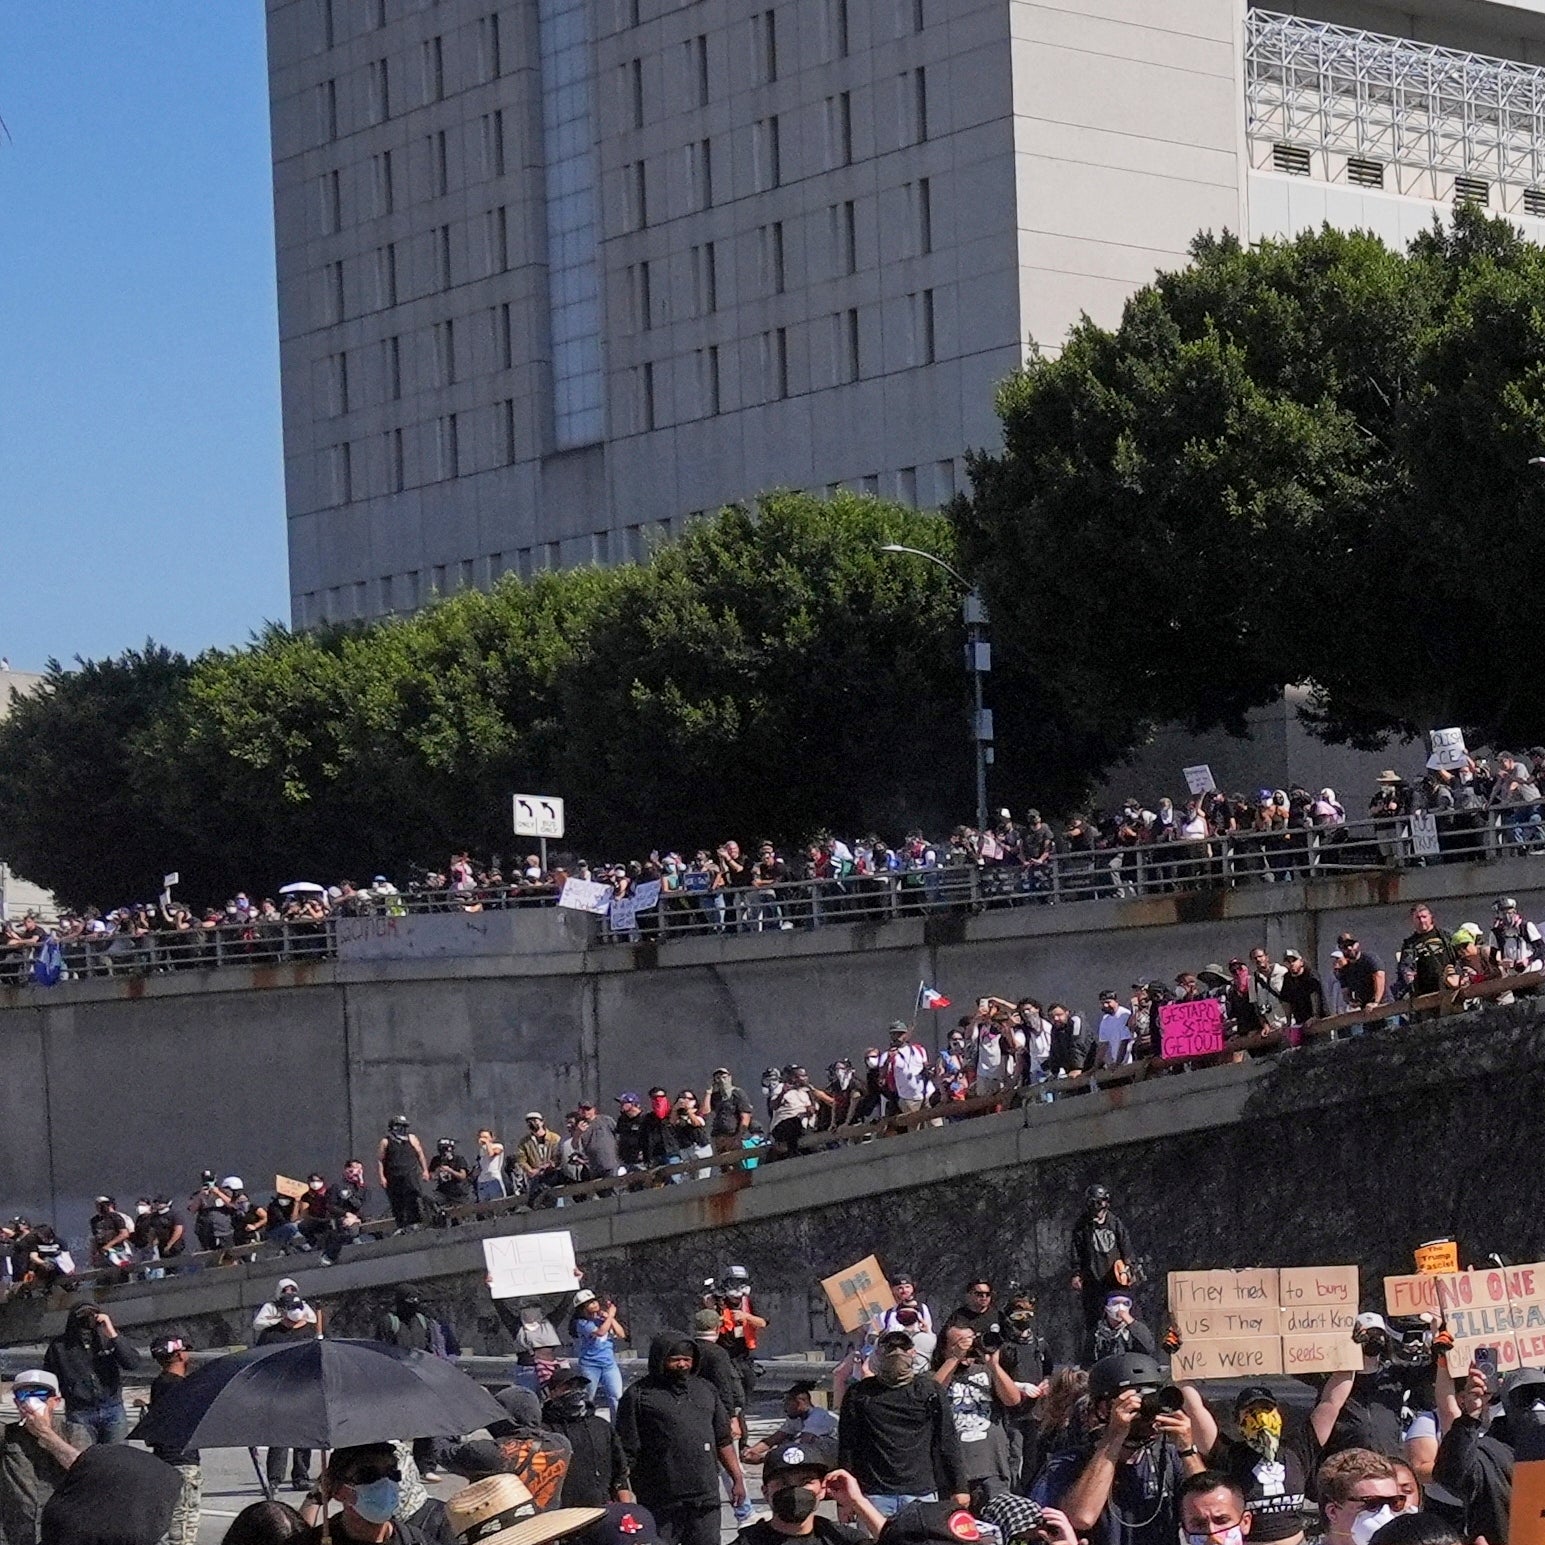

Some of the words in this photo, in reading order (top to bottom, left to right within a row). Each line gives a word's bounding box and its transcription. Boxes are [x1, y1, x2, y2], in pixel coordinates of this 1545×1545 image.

[1161, 1001, 1216, 1025] GESTAPO
[1164, 1036, 1192, 1057] GET
[1194, 1033, 1221, 1051] OUT
[1419, 1260, 1456, 1271] Fascist
[1421, 1252, 1451, 1262] Trump
[1175, 1279, 1223, 1304] They
[1234, 1278, 1268, 1300] tried
[1286, 1283, 1304, 1299] to
[1315, 1279, 1348, 1300] bury
[1436, 1275, 1474, 1309] NO
[1486, 1269, 1535, 1301] ONE
[1218, 1350, 1264, 1367] were
[1288, 1343, 1325, 1364] seeds
